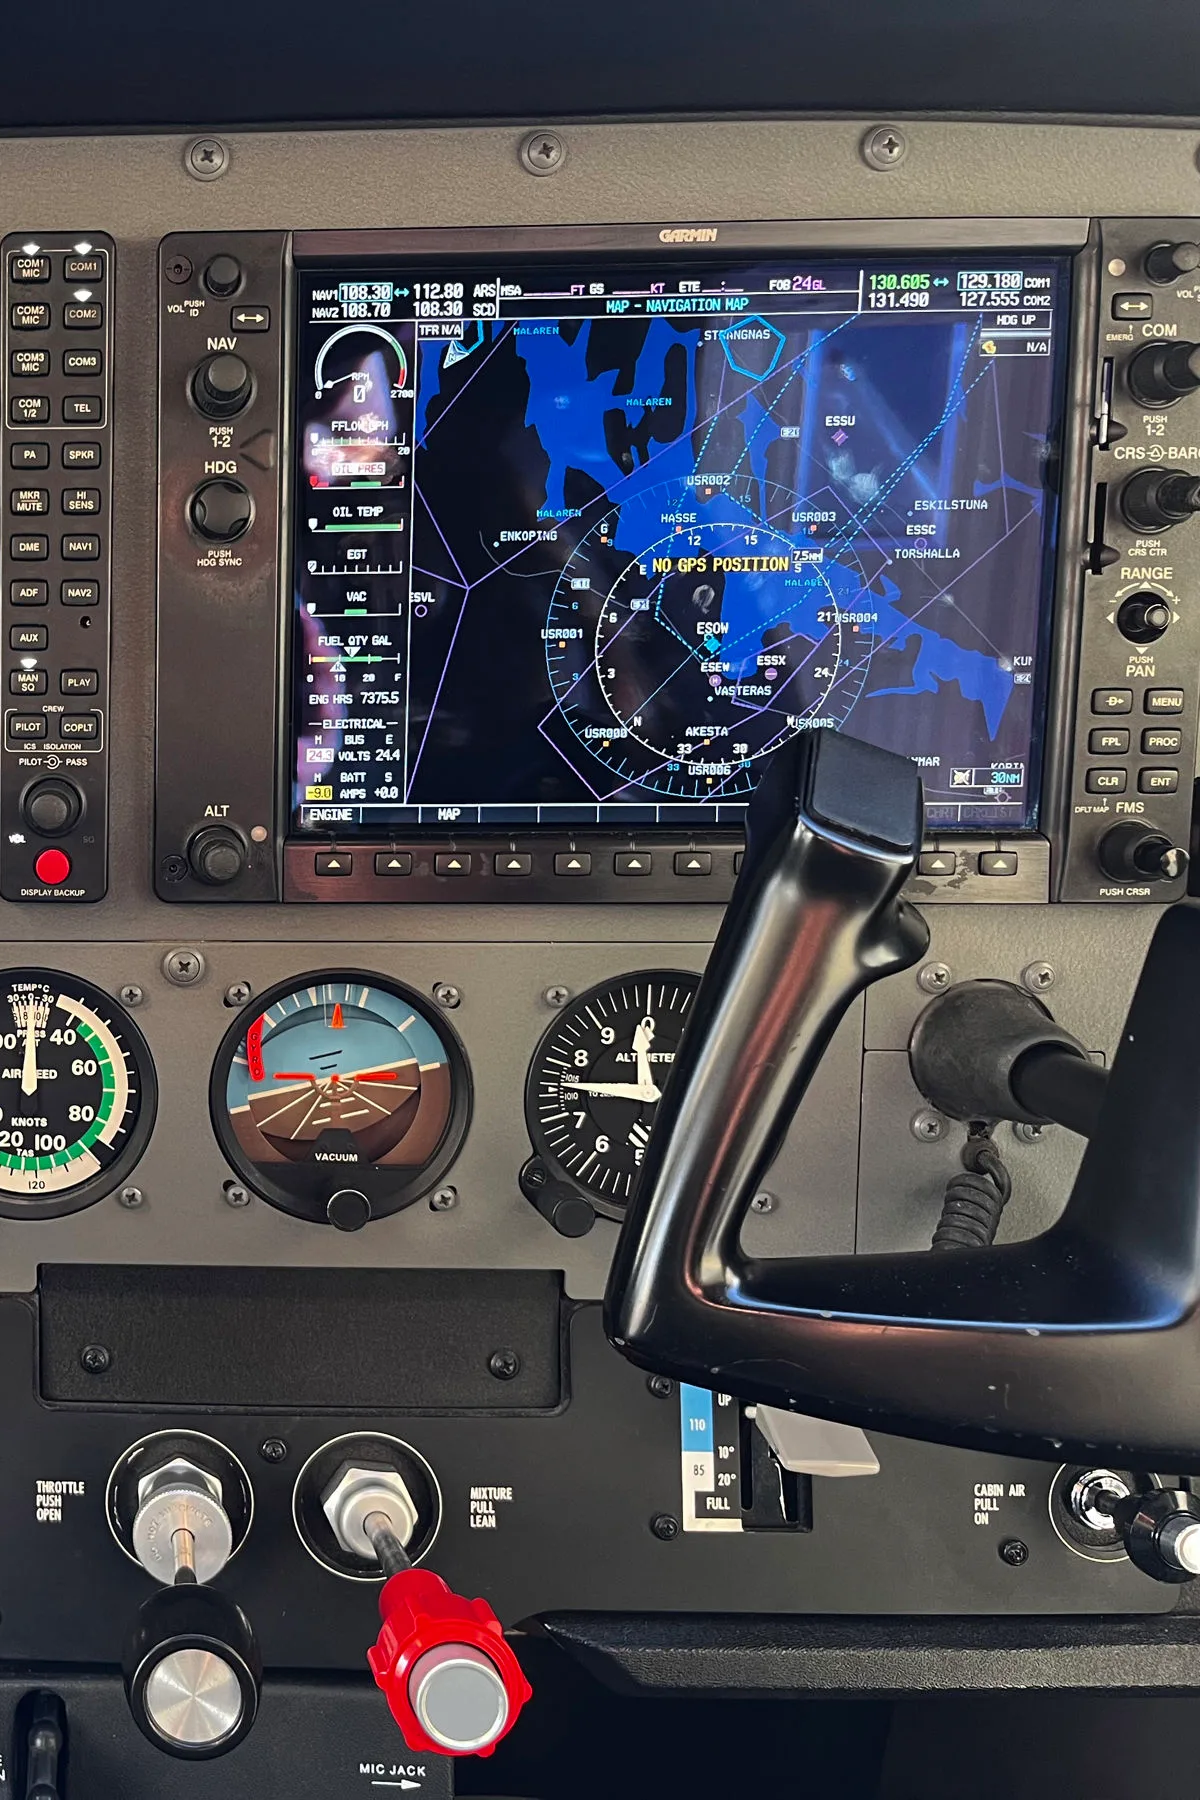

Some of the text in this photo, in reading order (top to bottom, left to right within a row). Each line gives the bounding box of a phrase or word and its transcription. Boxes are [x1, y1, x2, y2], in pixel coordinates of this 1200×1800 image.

[660, 228, 716, 242] GARMIN
[17, 259, 44, 268] COM1
[22, 268, 40, 277] MIC
[869, 274, 1050, 289] 130.605 129.180 COM1
[312, 285, 390, 300] NAV1 108.30
[869, 291, 1020, 308] 131.490 127.555
[17, 307, 45, 315] COM2
[607, 298, 748, 313] MAP NAVIGATION MAP
[1026, 342, 1047, 353] N/A
[17, 353, 44, 362] COM3
[627, 398, 672, 406] MALAREN
[74, 404, 91, 413] TEL
[826, 415, 855, 426] ESSU
[69, 450, 94, 459] SPKR
[205, 461, 237, 473] HDG
[915, 500, 988, 510] ESKILSTUNA
[333, 507, 383, 517] OIL TEMP
[792, 512, 836, 522] USR003
[661, 513, 696, 523] HASSE
[907, 525, 936, 535] ESSC
[501, 531, 557, 542] ENKOPING
[19, 543, 39, 551] DME
[69, 542, 92, 550] NAV1
[347, 549, 367, 559] EGT
[895, 548, 960, 559] TORSHALLA
[653, 557, 789, 572] NO GPS POSITION
[1121, 567, 1173, 579] RANGE
[20, 588, 38, 597] ADF
[346, 591, 367, 601] VAC
[697, 622, 728, 635] ESOW
[20, 634, 38, 642] AUX
[319, 635, 391, 646] FUEL GAL
[757, 656, 785, 666] ESSX
[68, 679, 90, 687] PLAY
[715, 686, 771, 696] VASTERAS
[310, 692, 399, 704] ENG HRS 7375.5
[1152, 697, 1182, 706] MENU
[15, 722, 41, 731] PILOT
[64, 723, 93, 732] COPLT
[323, 719, 385, 729] ELECTRICAL
[686, 727, 728, 737] AKESTA
[44, 743, 81, 751] ISOLATION
[339, 750, 400, 761] VOLTS 24.4
[991, 772, 1019, 783] 30NM
[1116, 802, 1144, 813] FMS
[310, 810, 352, 820] ENGINE
[54, 889, 85, 897] BACKUP
[50, 1029, 76, 1045] 40
[69, 1106, 94, 1122] 80
[11, 1117, 47, 1127] KNOTS
[35, 1134, 65, 1150] 100
[315, 1153, 357, 1161] VACUUM
[689, 1418, 705, 1431] 110
[693, 1464, 705, 1476] 85
[36, 1481, 84, 1493] THROTTLE
[974, 1484, 1025, 1496] CABIN AIR
[471, 1488, 512, 1499] MIXTURE
[37, 1495, 62, 1507] PUSH
[707, 1497, 730, 1510] FULL
[974, 1499, 999, 1511] PULL
[37, 1509, 62, 1520] OPEN
[471, 1515, 496, 1528] LEAN
[360, 1764, 426, 1777] MIC JACK
